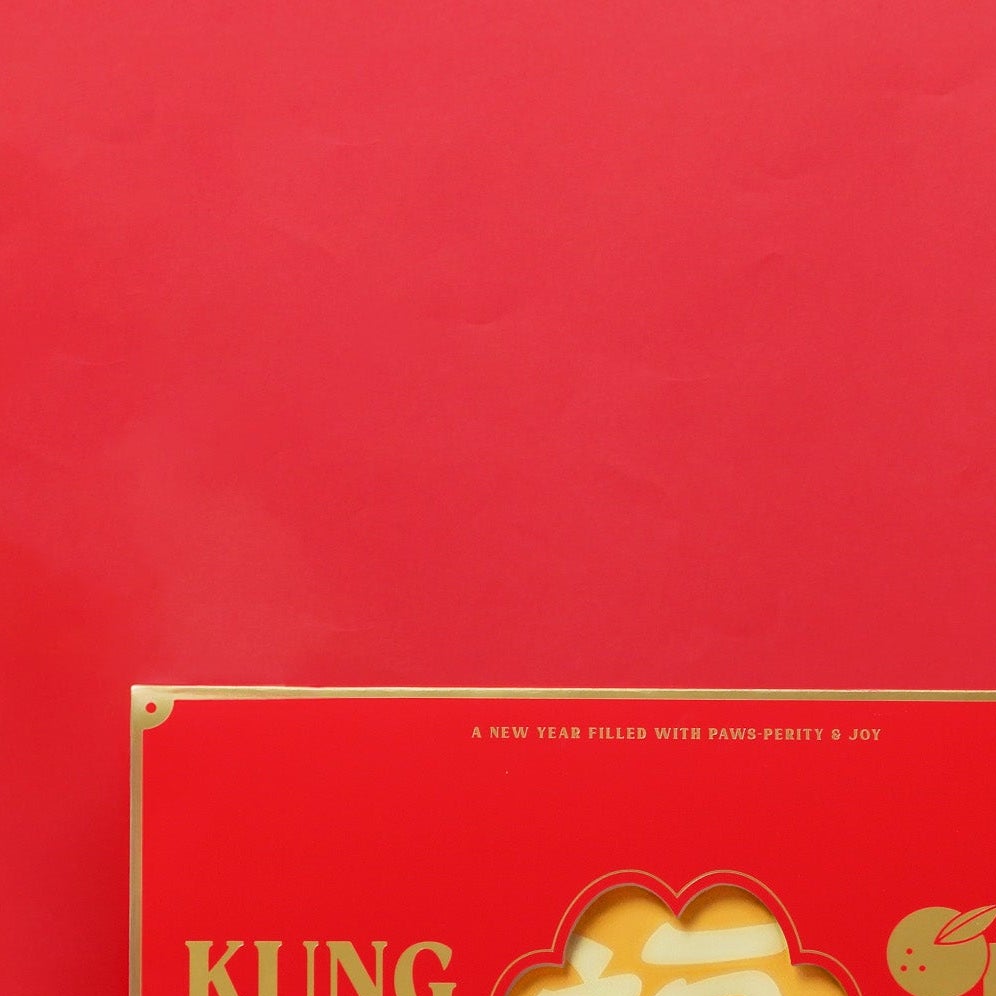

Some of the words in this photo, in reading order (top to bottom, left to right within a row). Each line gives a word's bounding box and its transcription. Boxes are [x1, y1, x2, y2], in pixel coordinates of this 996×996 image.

[471, 726, 482, 739] A
[489, 726, 529, 739] NEW
[536, 726, 581, 739] YEAR
[588, 726, 647, 740] FILLED
[653, 727, 701, 740] WITH
[708, 727, 824, 741] PAWS-PERITY
[831, 728, 842, 741] &
[848, 728, 881, 741] JOY
